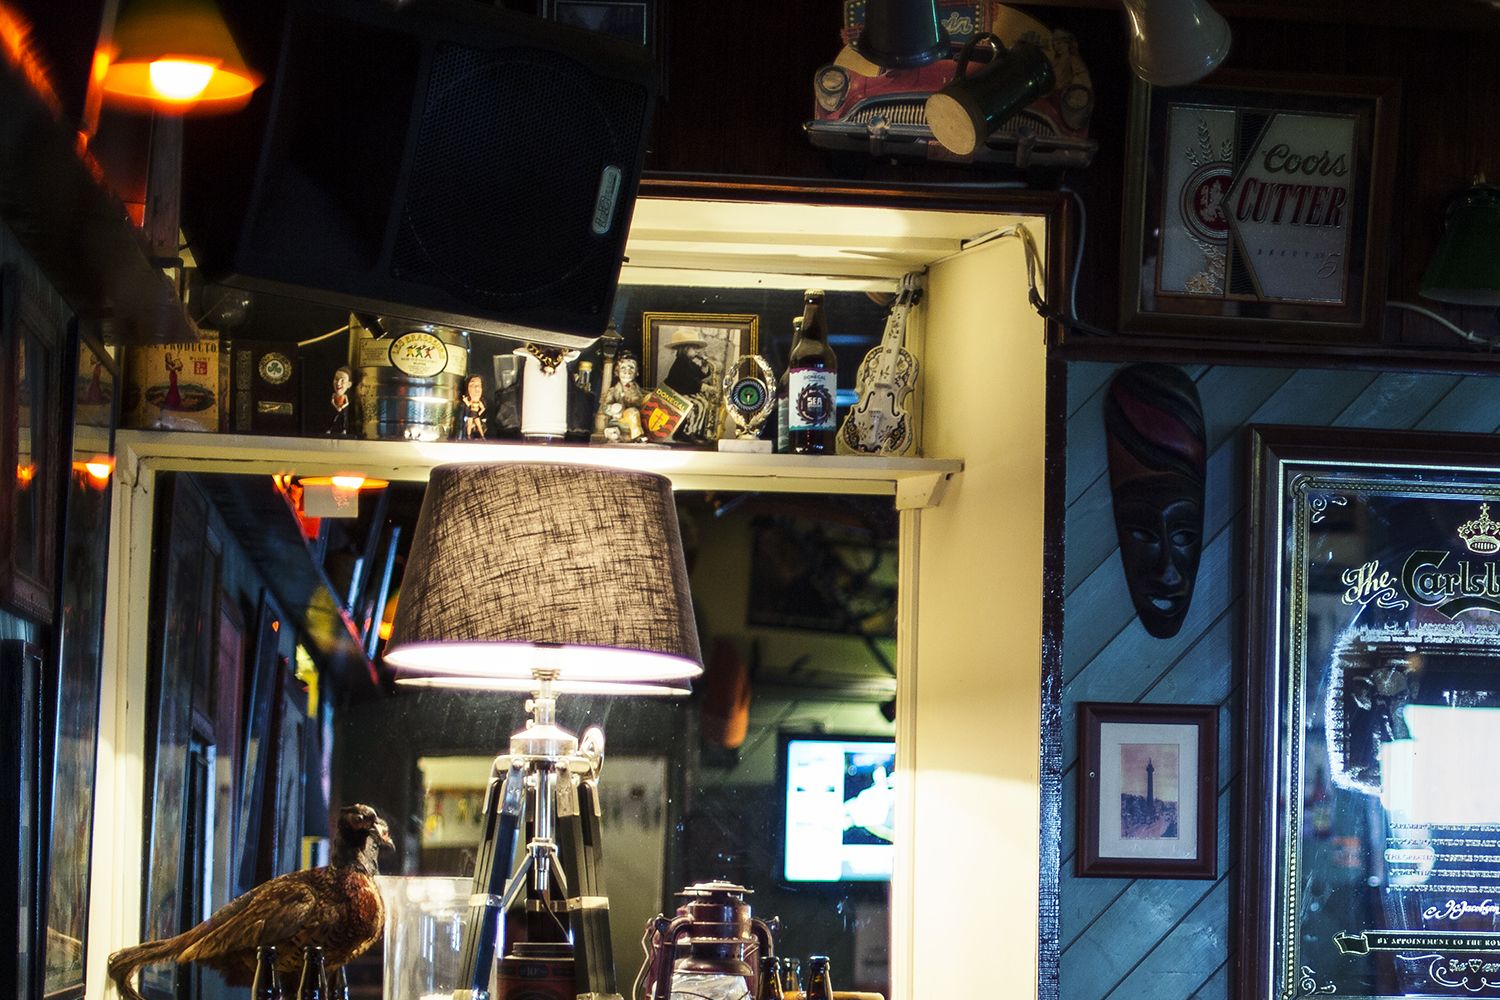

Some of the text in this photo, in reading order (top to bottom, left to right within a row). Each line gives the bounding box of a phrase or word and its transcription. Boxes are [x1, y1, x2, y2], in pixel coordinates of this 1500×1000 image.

[1263, 143, 1347, 177] Coors
[1236, 177, 1346, 228] CUTTER
[656, 387, 687, 411] DONEGAL
[807, 396, 822, 408] SEA
[1341, 559, 1400, 607] The
[1377, 937, 1389, 945] BY
[1391, 938, 1449, 946] APPOINTMENT
